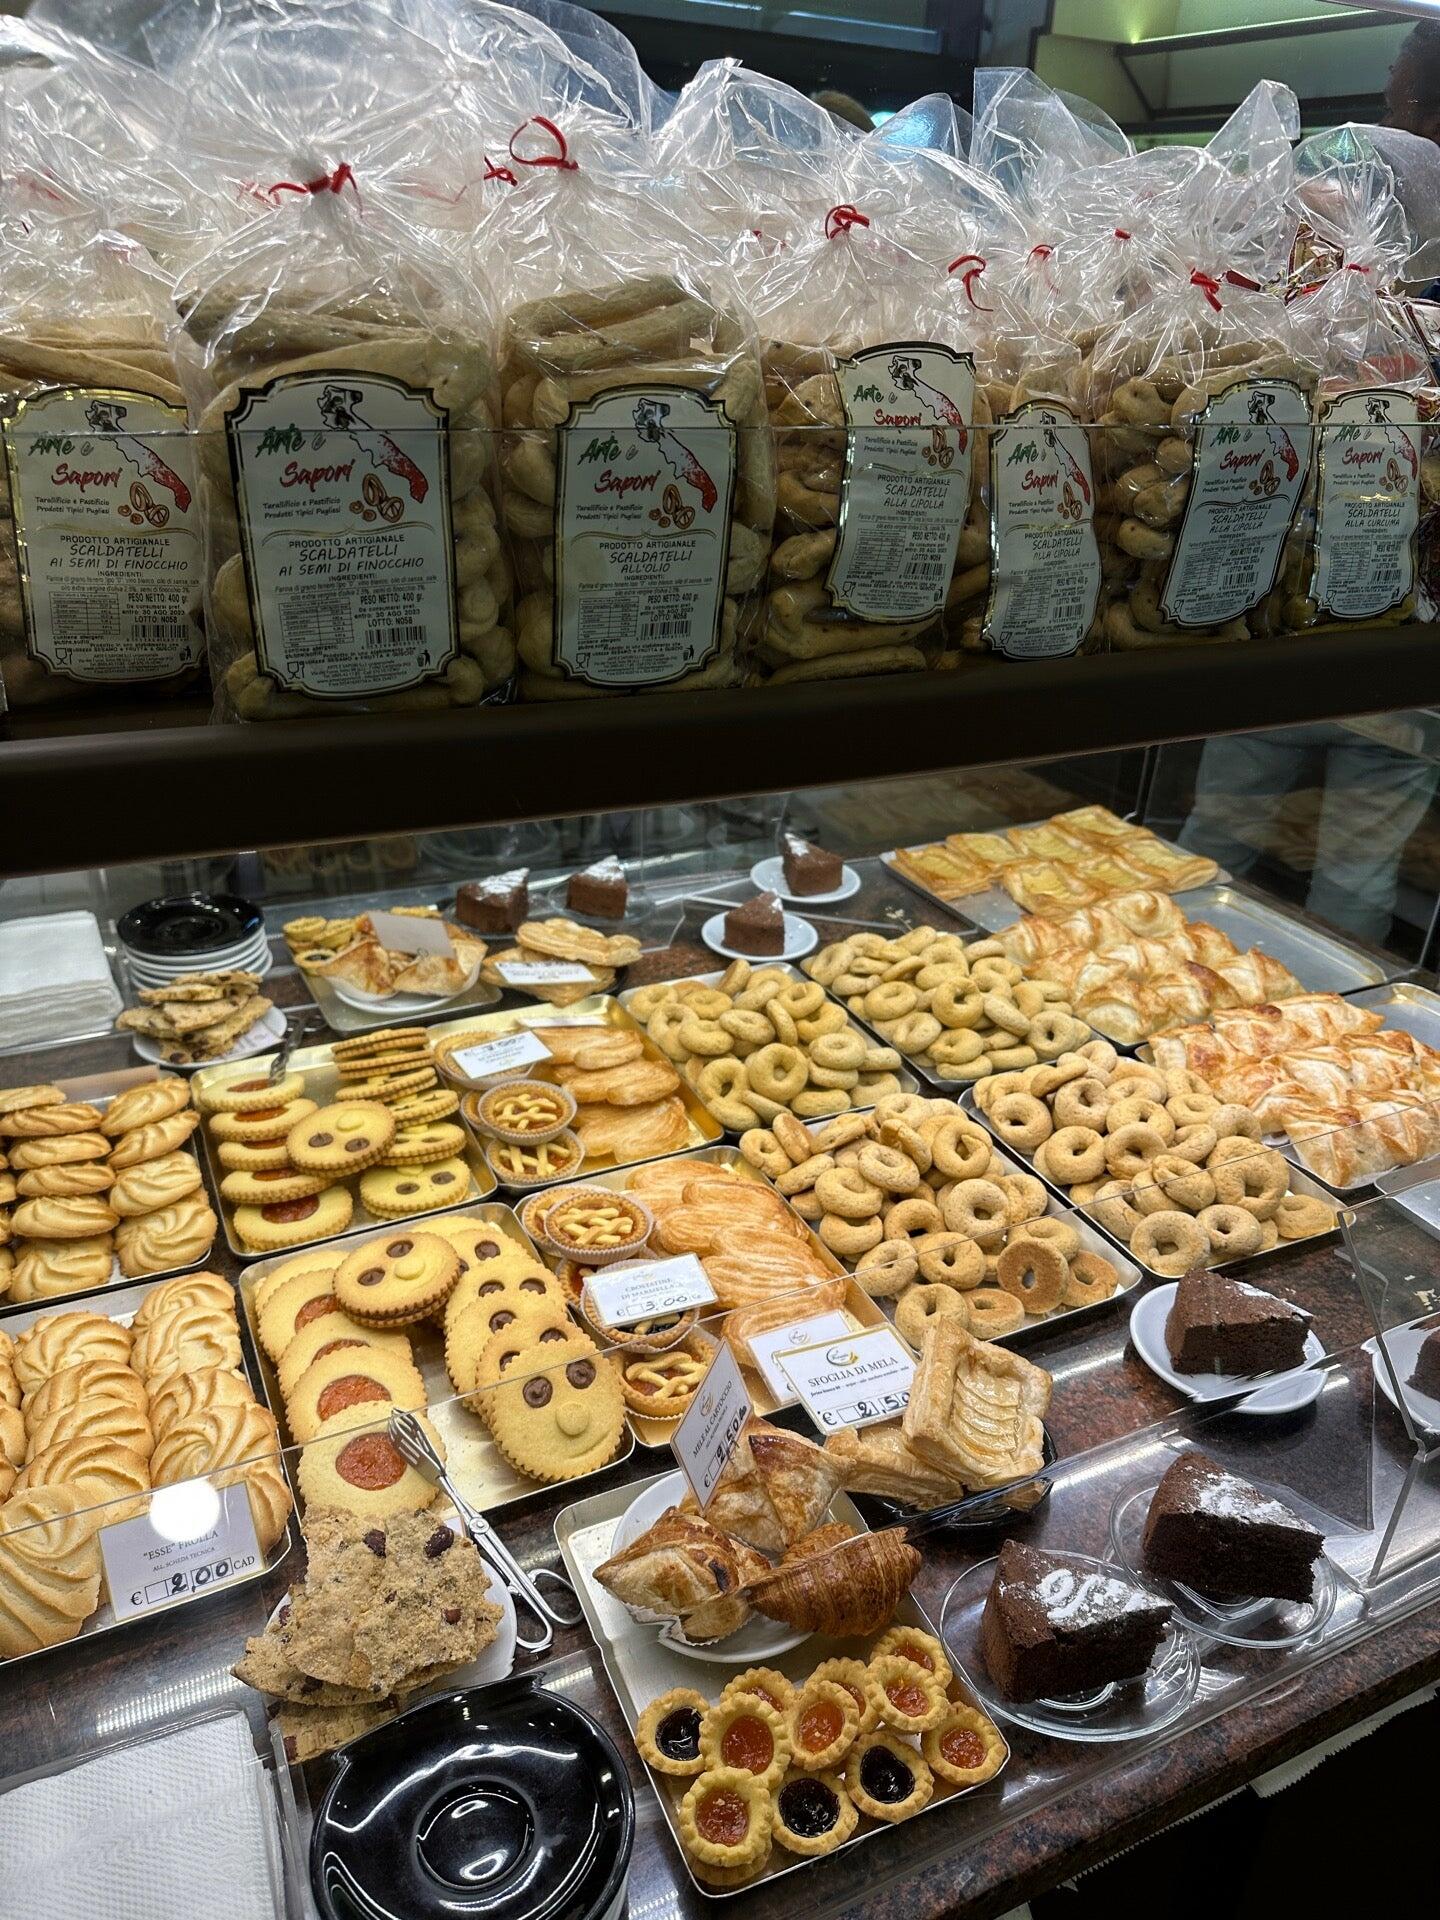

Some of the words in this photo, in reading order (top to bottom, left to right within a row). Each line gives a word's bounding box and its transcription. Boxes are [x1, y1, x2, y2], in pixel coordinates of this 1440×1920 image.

[854, 385, 884, 402] Arte
[889, 392, 898, 404] e
[874, 408, 922, 433] Sapori
[256, 424, 306, 457] Arte
[1210, 424, 1240, 447] Arte
[577, 432, 622, 465] Arte
[625, 444, 639, 460] e
[1007, 440, 1039, 467] Arte
[1220, 449, 1266, 474] Sapori
[1342, 446, 1386, 470] Sapori
[51, 462, 123, 493] Sapori
[279, 458, 355, 492] Sapori
[877, 474, 913, 484] PRODOTTO
[914, 476, 951, 486] ARTIGIANALE
[1022, 469, 1059, 495] Sapori
[594, 469, 662, 499] Sapori
[884, 484, 948, 498] SCALDATELLI
[35, 496, 71, 505] Tarallificio
[80, 497, 110, 506] Pastificio
[263, 501, 300, 510] Tarallificio
[309, 497, 341, 506] Pastificio
[883, 499, 907, 508] ALLA
[910, 499, 945, 509] CIPOLLA
[36, 505, 65, 513] Prodotti
[67, 506, 85, 514] Tipici
[86, 507, 110, 515] Pugliesi
[264, 510, 294, 519] Prodotti
[295, 508, 314, 519] Tipici
[316, 507, 341, 516] Pugliesi
[620, 513, 642, 521] Pugliesi
[1208, 506, 1237, 515] PRODOTTO
[1348, 508, 1401, 518] SCALDATELLI
[1211, 511, 1267, 525] SCALDATELLI
[1345, 519, 1364, 527] ALLA
[1367, 519, 1400, 527] CURCUMA
[1209, 525, 1230, 534] ALLA
[1232, 521, 1264, 531] CIPOLLA
[60, 535, 109, 545] PRODOTTO
[114, 537, 170, 546] ARTIGIANALE
[289, 538, 341, 549] PRODOTTO
[345, 534, 405, 545] ARTIGIANALE
[1025, 531, 1053, 539] PRODOTTO
[599, 541, 643, 550] PRODOTTO
[646, 540, 696, 549] ARTIGIANALE
[1032, 536, 1083, 551] SCALDATELLI
[70, 544, 164, 558] SCALDATELLI
[299, 544, 398, 562] SCALDATELLI
[610, 550, 693, 564] SCALDATELLI
[1053, 549, 1081, 559] CIPOLLA
[50, 557, 63, 567] AI
[69, 558, 99, 568] SEMI
[107, 559, 119, 569] DI
[124, 560, 188, 571] FINOCCHIO
[279, 566, 292, 577] AI
[299, 563, 331, 576] SEMI
[338, 562, 350, 573] DI
[357, 557, 424, 571] FINOCCHIO
[621, 563, 671, 574] ALL'OLIO
[128, 593, 144, 603] PESO
[168, 593, 181, 603] 400
[360, 594, 377, 604] PESO
[378, 593, 400, 604] NETTO:
[402, 592, 415, 602] 400
[648, 594, 661, 604] PESO
[681, 593, 692, 602] 400
[368, 619, 393, 628] LOTTO:
[624, 1277, 674, 1292] CROSTATINE
[807, 1369, 855, 1387] SFOGLIA
[853, 1365, 868, 1376] DI
[867, 1356, 899, 1371] MELA
[693, 1433, 706, 1459] MELE
[702, 1424, 712, 1439] AL
[709, 1380, 733, 1426] CARTOCCIO
[822, 1411, 838, 1426] €
[704, 1473, 712, 1488] €
[165, 1555, 190, 1568] SCHEDA
[189, 1546, 217, 1561] TECNICA
[130, 1591, 144, 1606] €
[233, 1555, 256, 1570] CAD
